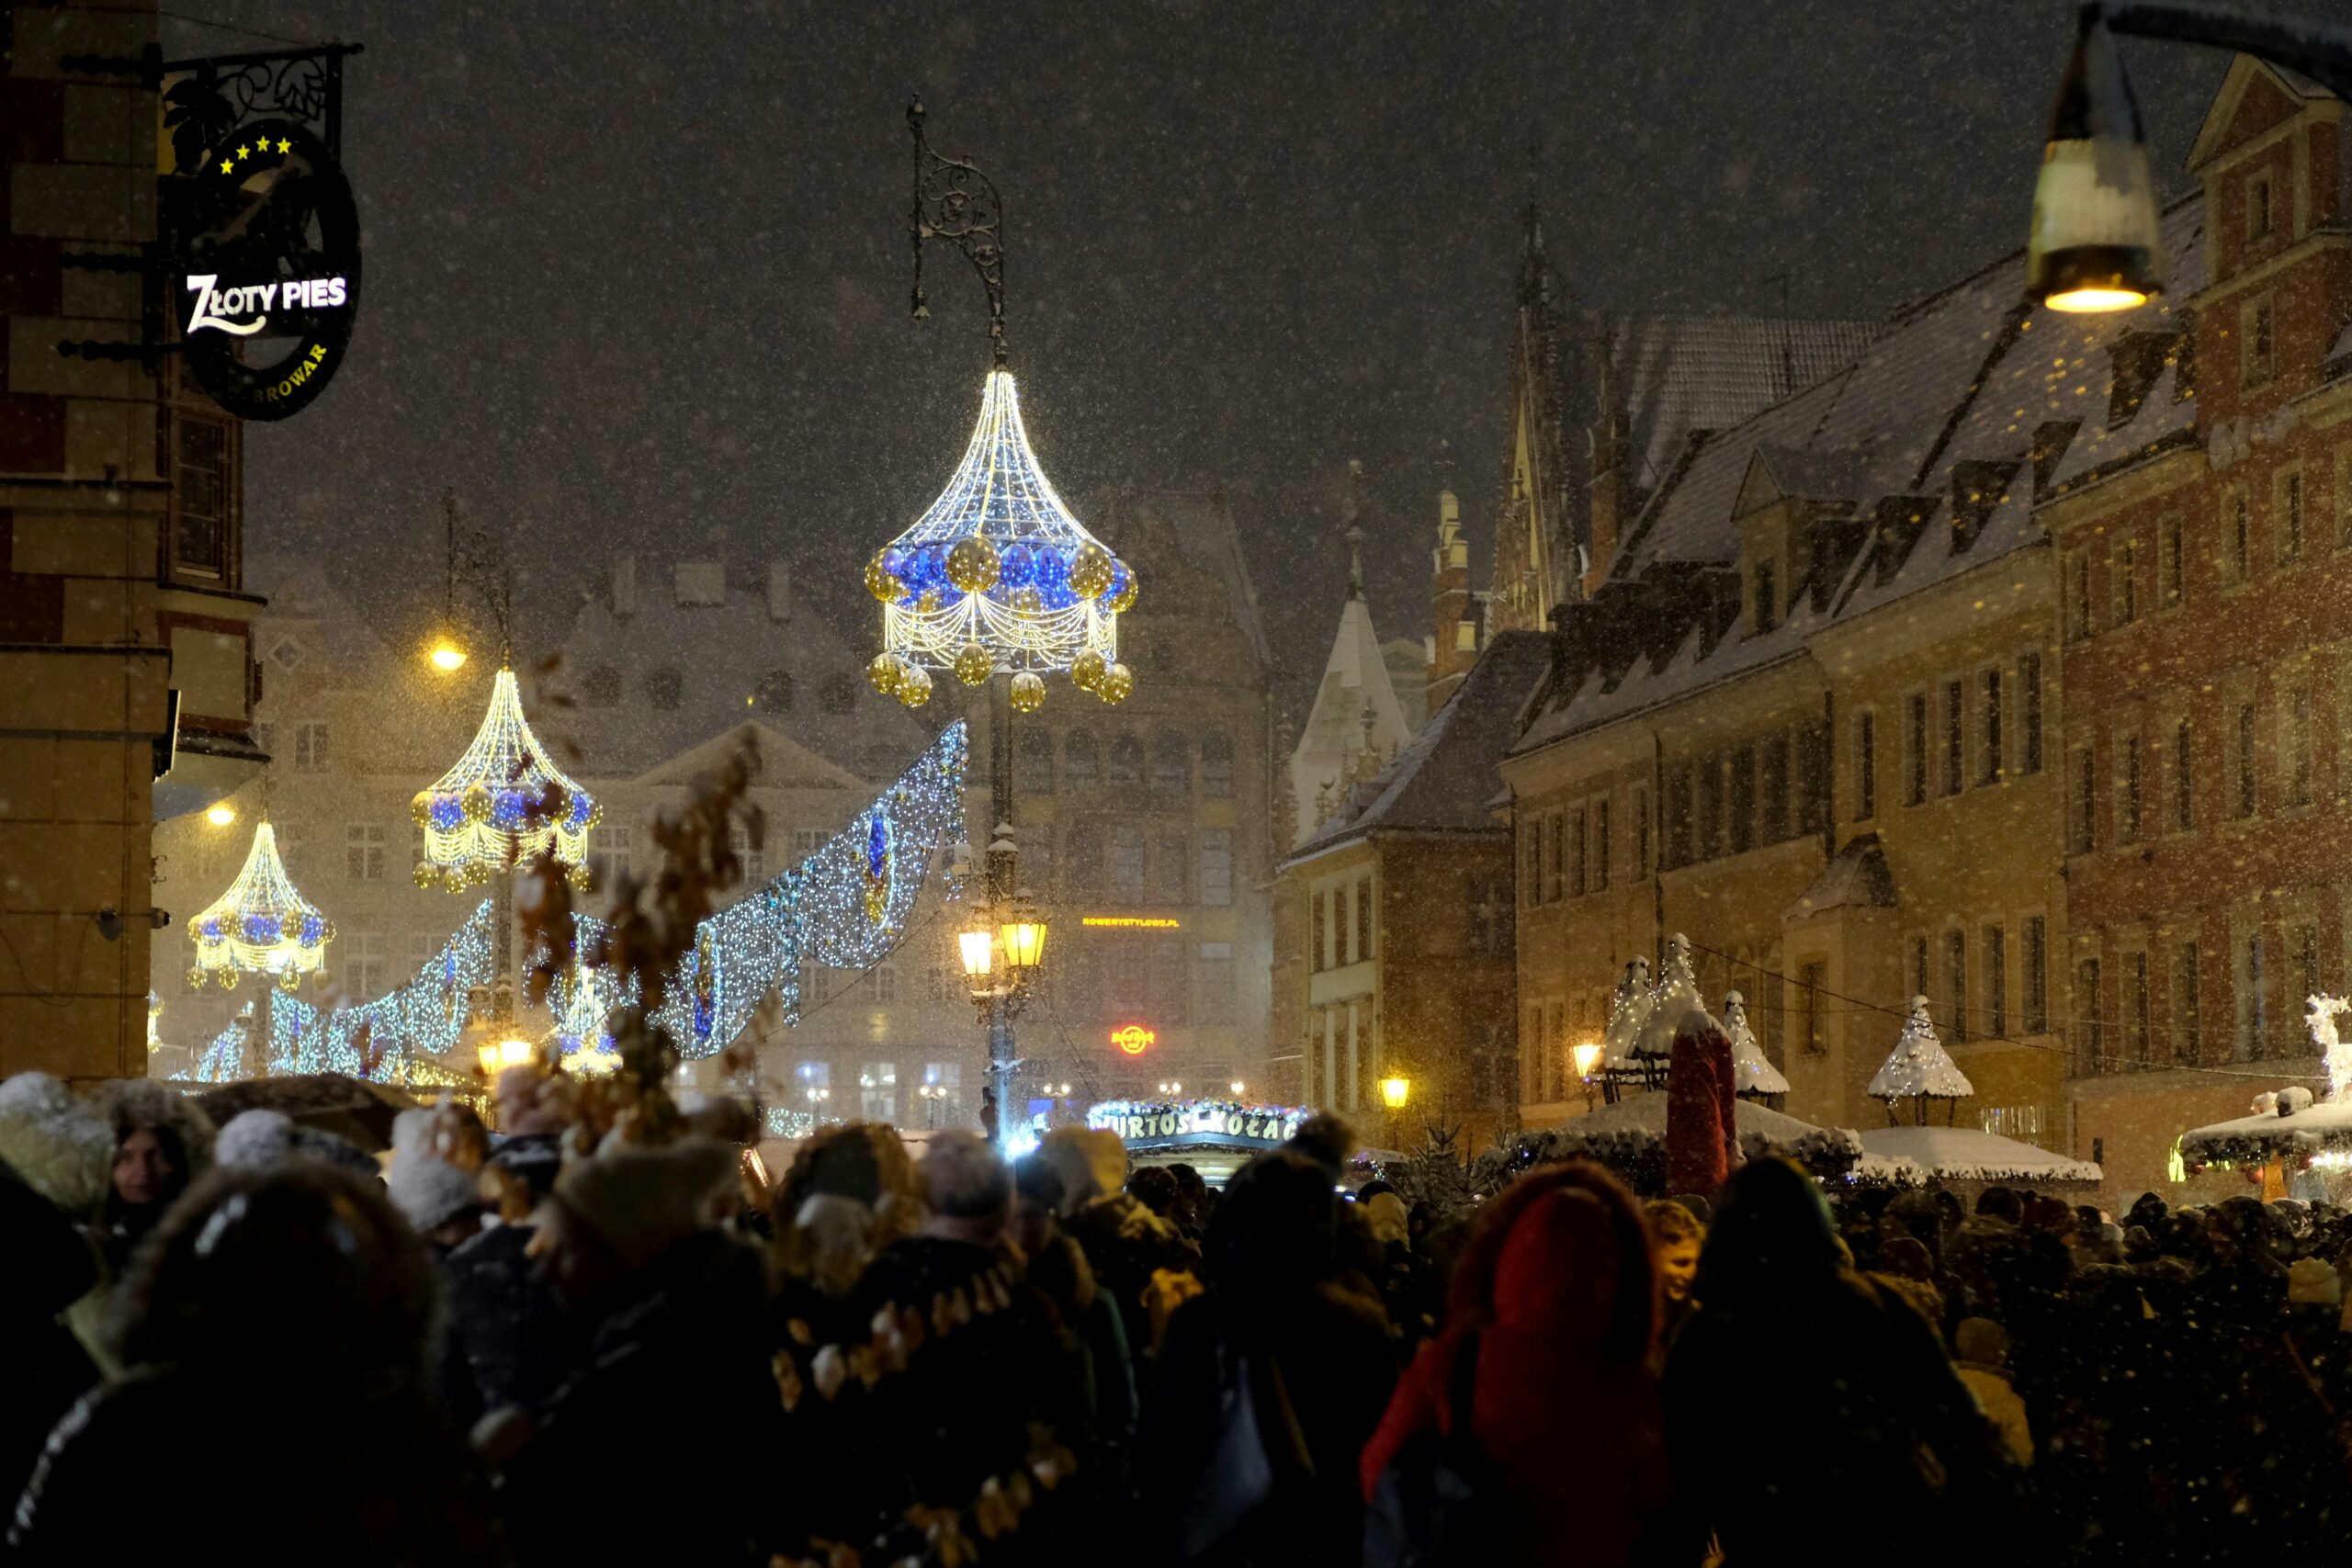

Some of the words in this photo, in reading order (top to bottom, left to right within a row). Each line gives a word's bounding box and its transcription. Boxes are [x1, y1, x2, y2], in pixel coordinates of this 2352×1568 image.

[187, 274, 277, 335] ZŁOTY
[282, 277, 347, 310] PIES
[254, 344, 327, 403] BROWAR
